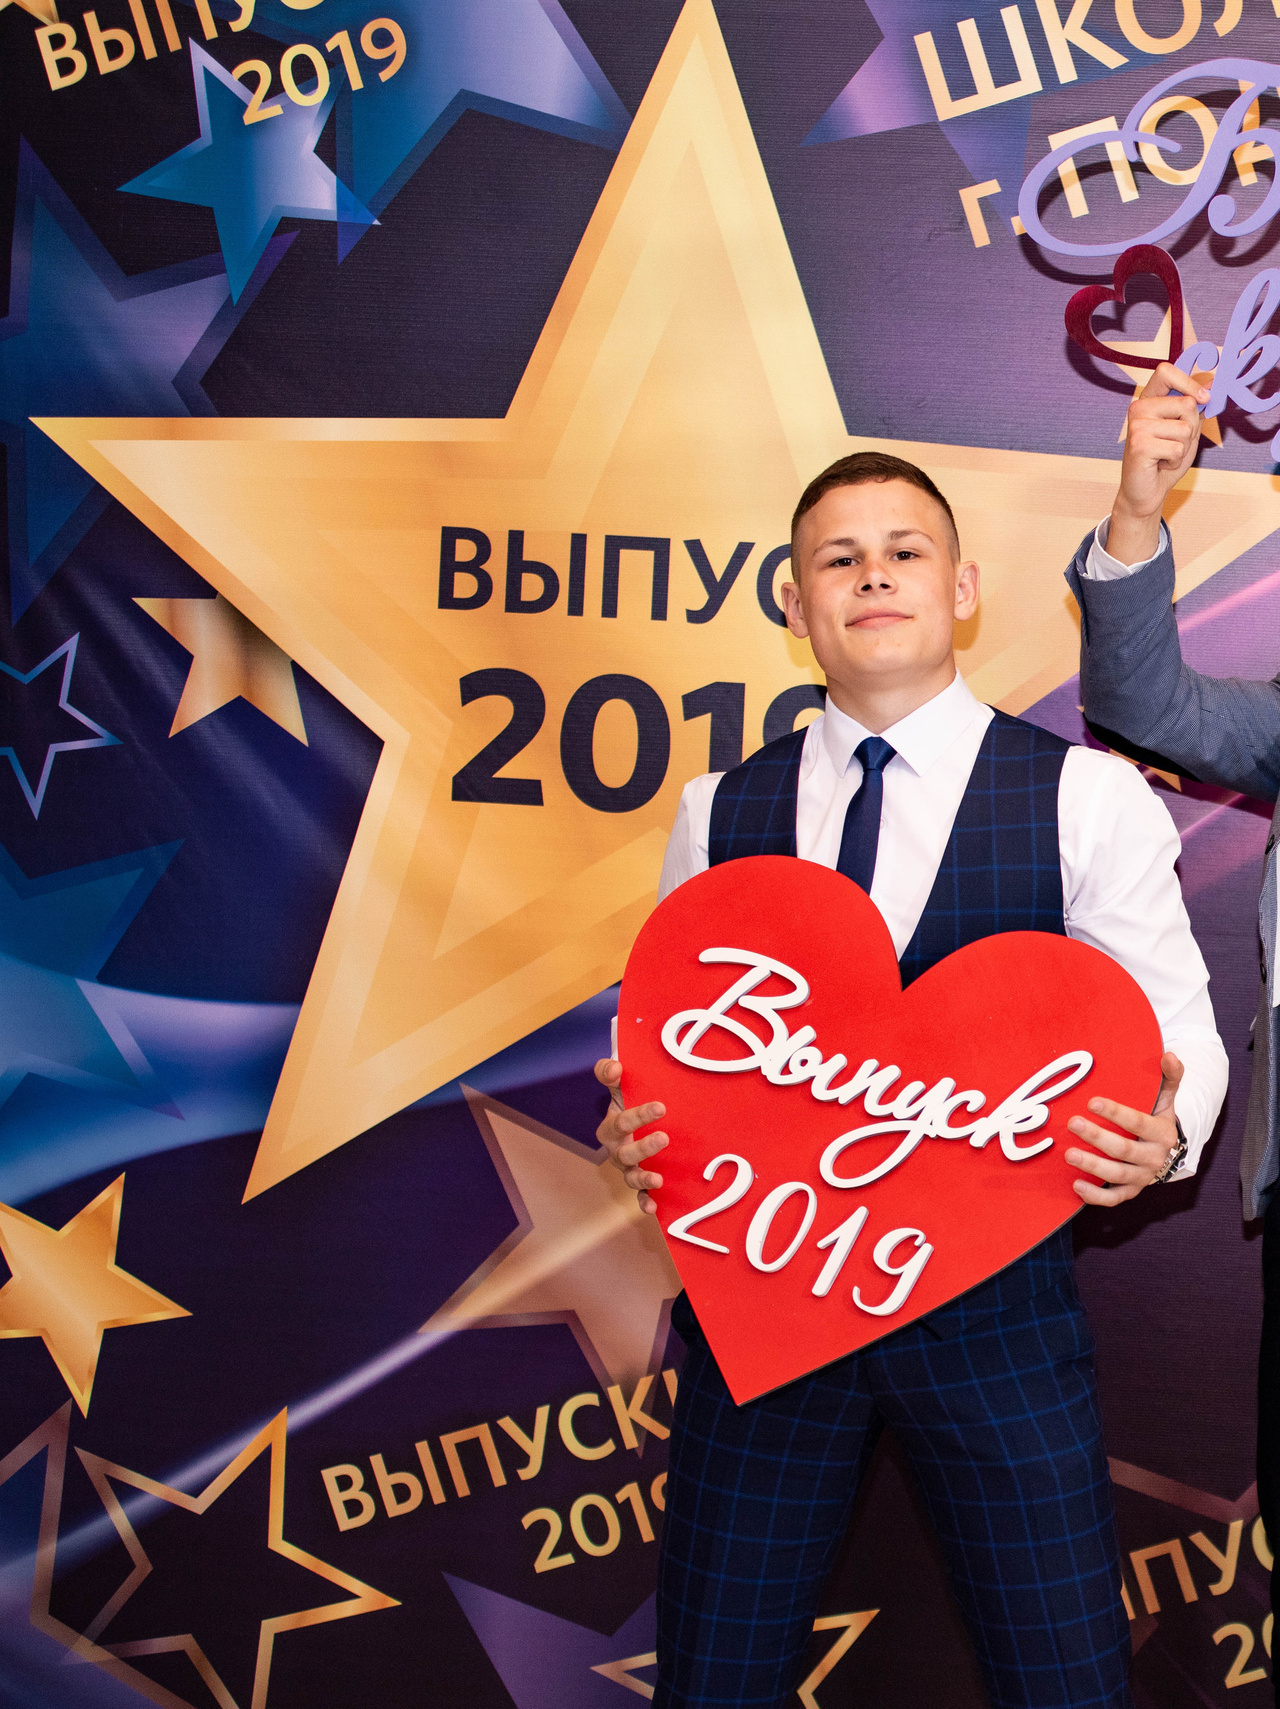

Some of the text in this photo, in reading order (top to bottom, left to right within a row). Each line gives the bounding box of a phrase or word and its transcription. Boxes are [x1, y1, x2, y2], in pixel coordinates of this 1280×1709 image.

[232, 17, 407, 126] 2019
[661, 947, 1095, 1189] Выпуск
[667, 1154, 934, 1317] 2019
[321, 1368, 678, 1532] ВЫПУСК
